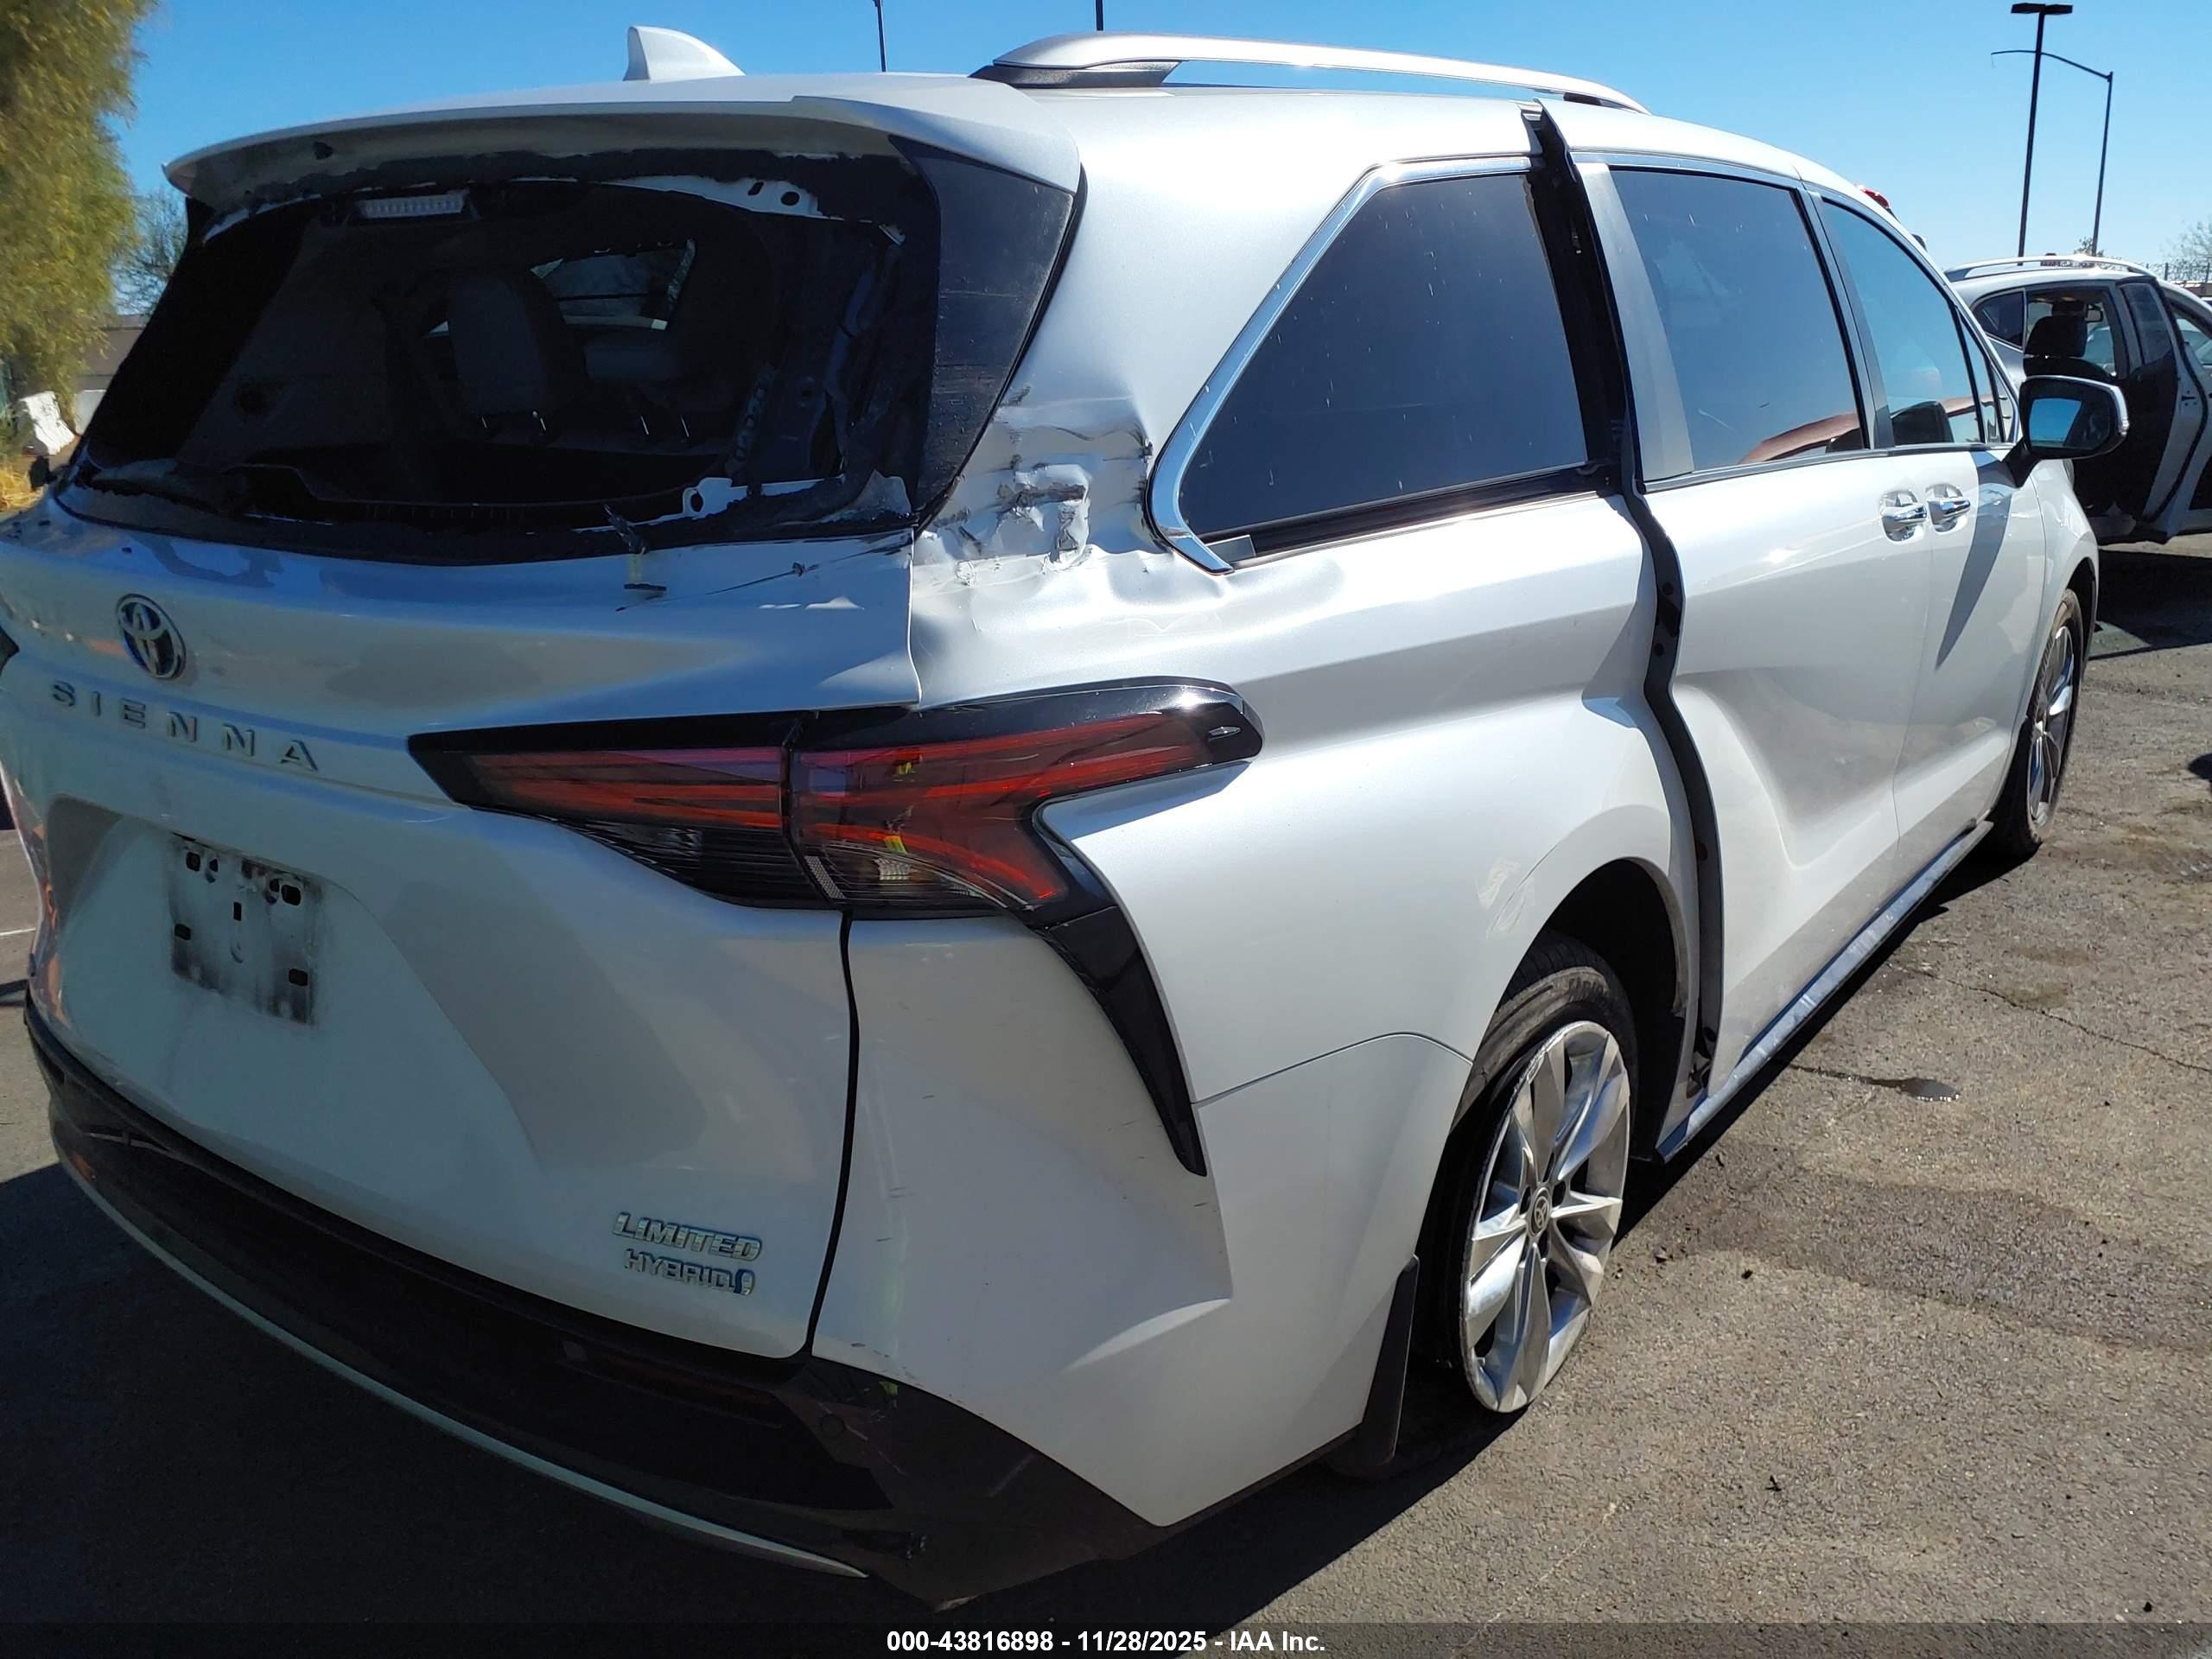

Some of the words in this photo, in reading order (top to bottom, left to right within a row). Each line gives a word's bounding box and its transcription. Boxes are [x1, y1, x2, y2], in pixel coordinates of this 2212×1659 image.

[52, 681, 319, 772] SIENNA
[613, 1211, 762, 1262] LIMITED
[624, 1248, 734, 1292] HYBRID
